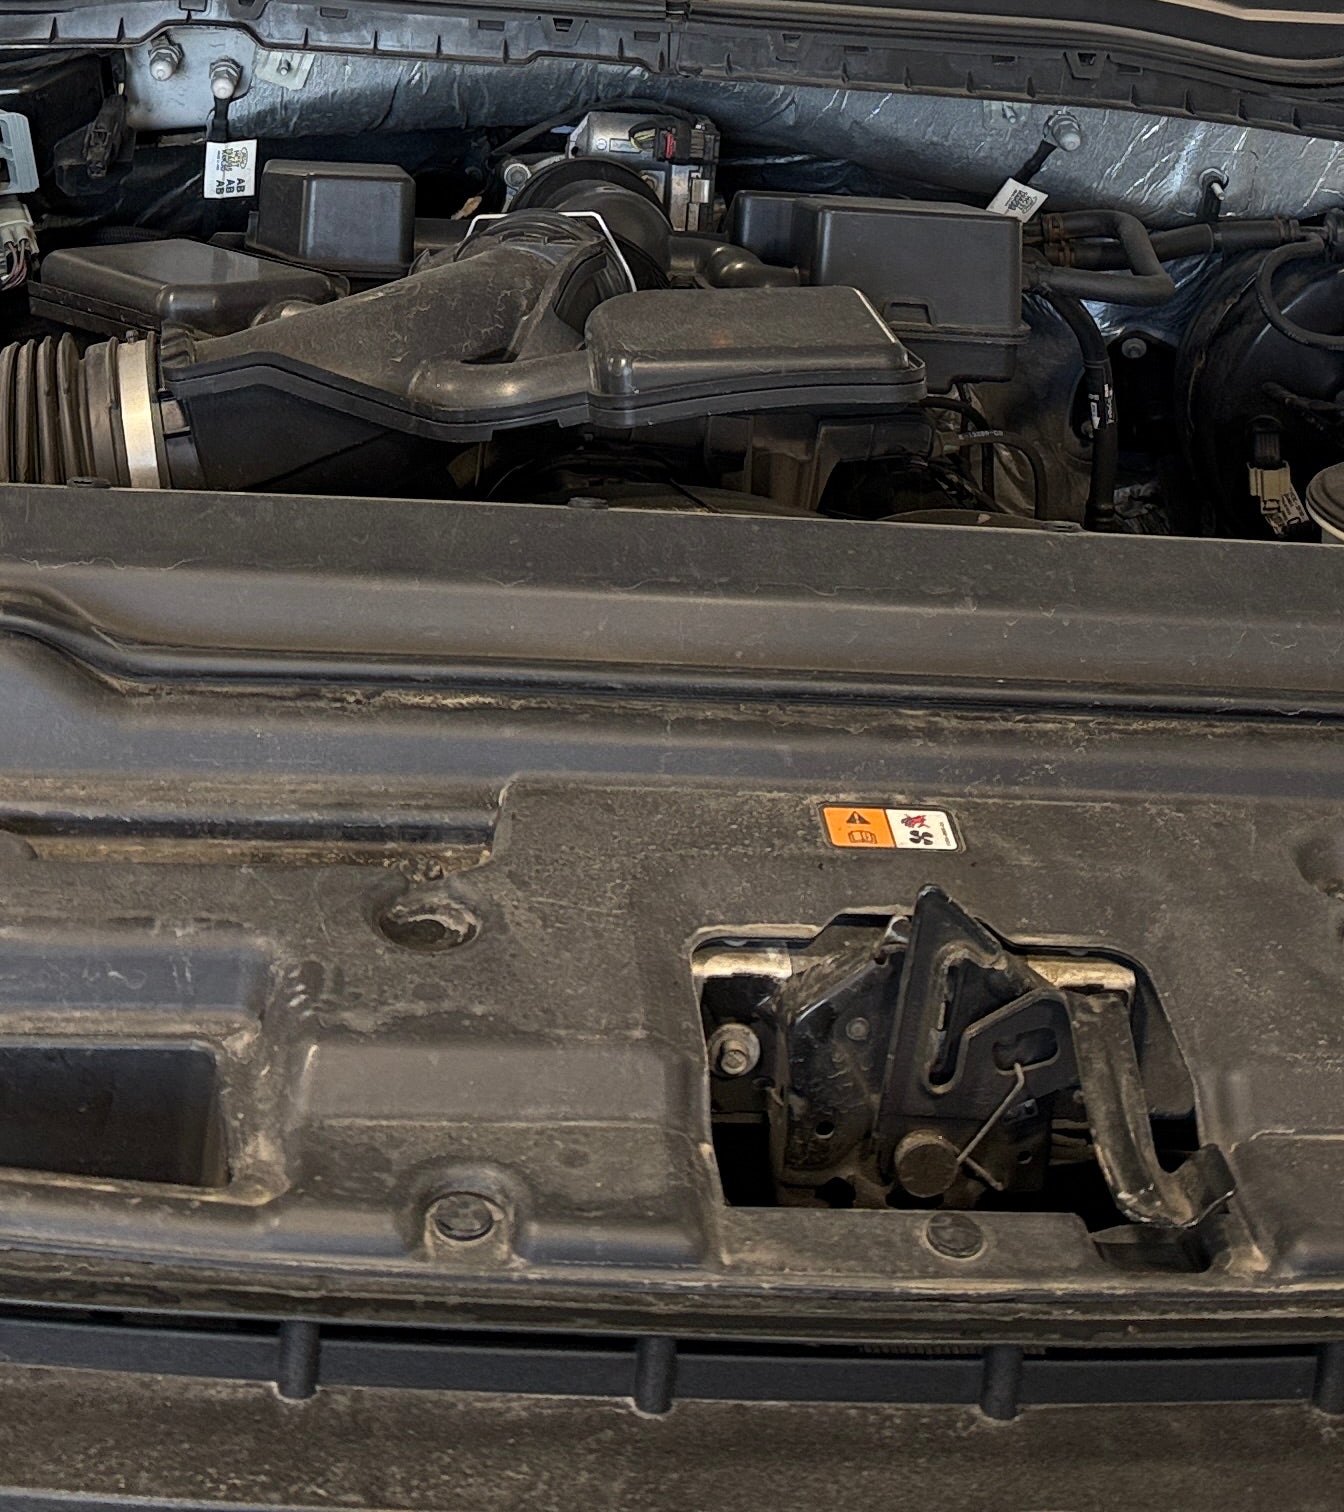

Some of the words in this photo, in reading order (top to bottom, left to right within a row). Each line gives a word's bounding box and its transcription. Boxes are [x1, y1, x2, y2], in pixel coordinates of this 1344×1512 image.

[216, 180, 226, 195] AB
[226, 179, 236, 194] AB
[236, 178, 246, 193] AB
